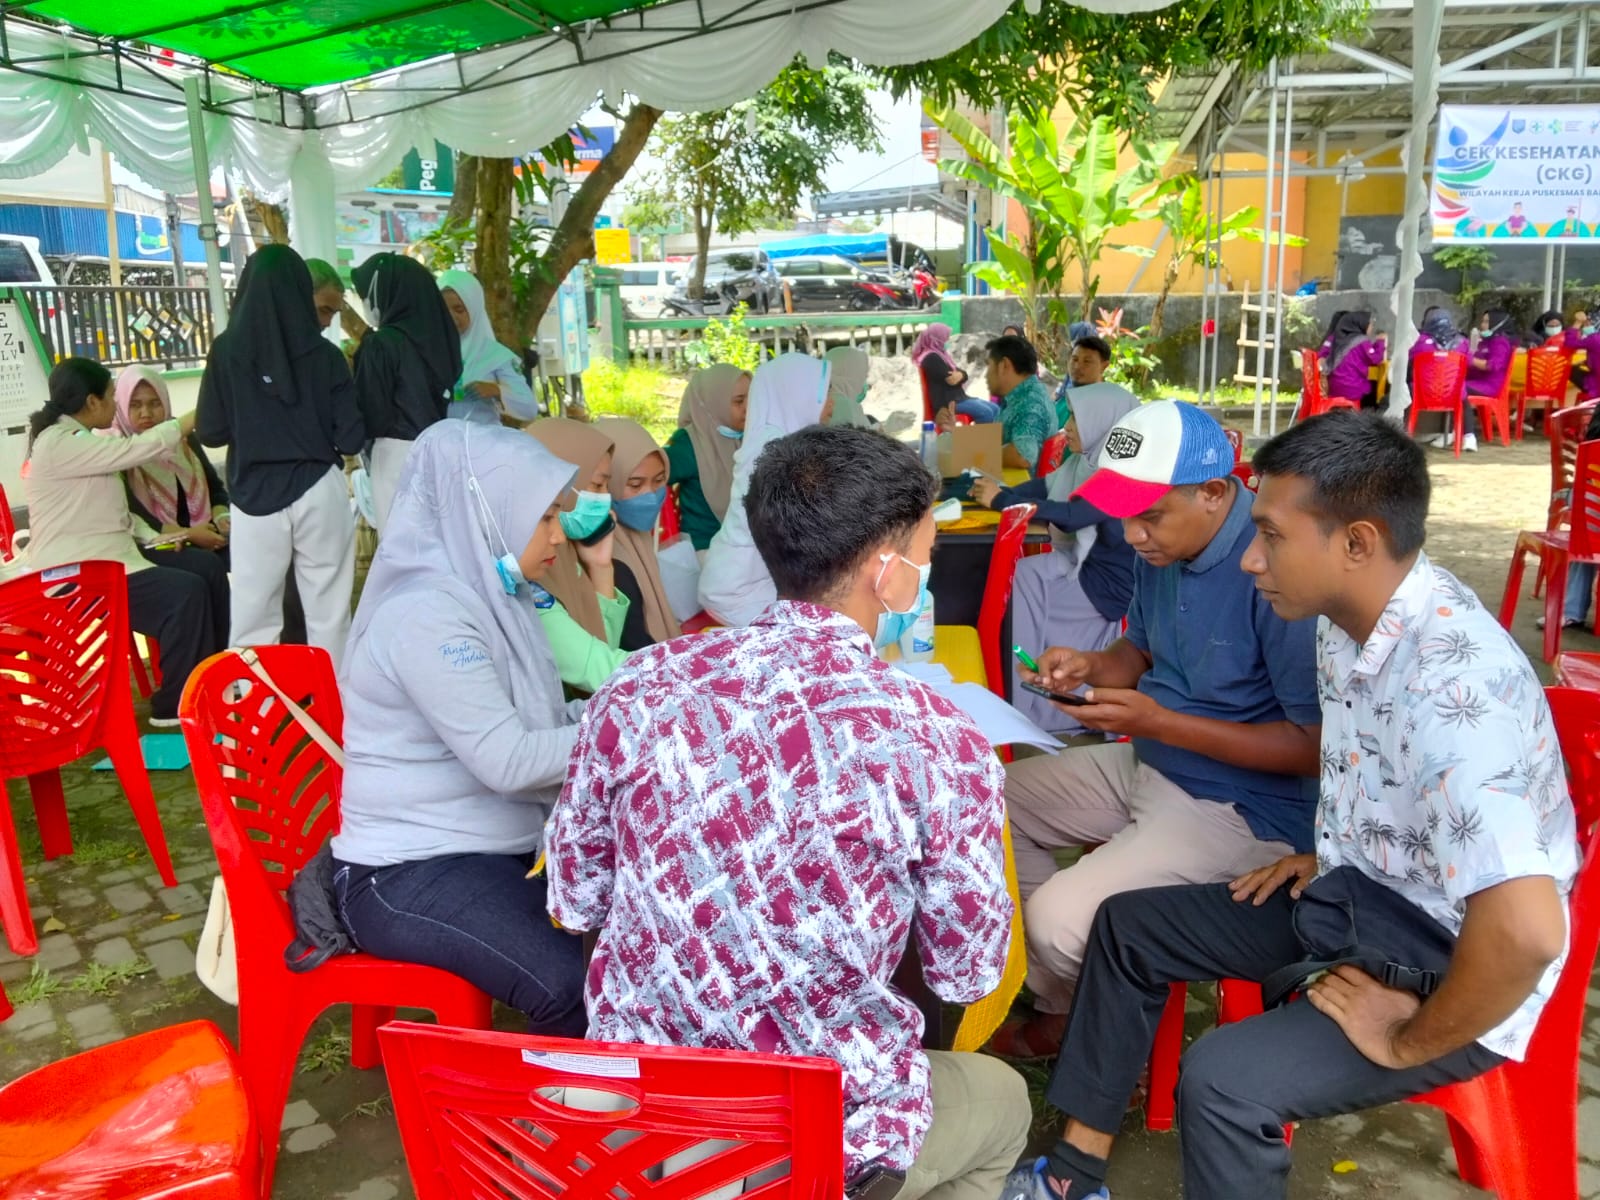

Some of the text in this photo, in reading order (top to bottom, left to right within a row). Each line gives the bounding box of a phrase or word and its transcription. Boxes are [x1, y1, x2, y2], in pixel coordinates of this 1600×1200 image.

[1454, 146, 1491, 160] CEK
[1536, 163, 1593, 185] (CKG)
[1458, 188, 1600, 198] WILAYAH KERJA PUSKESMAS BA
